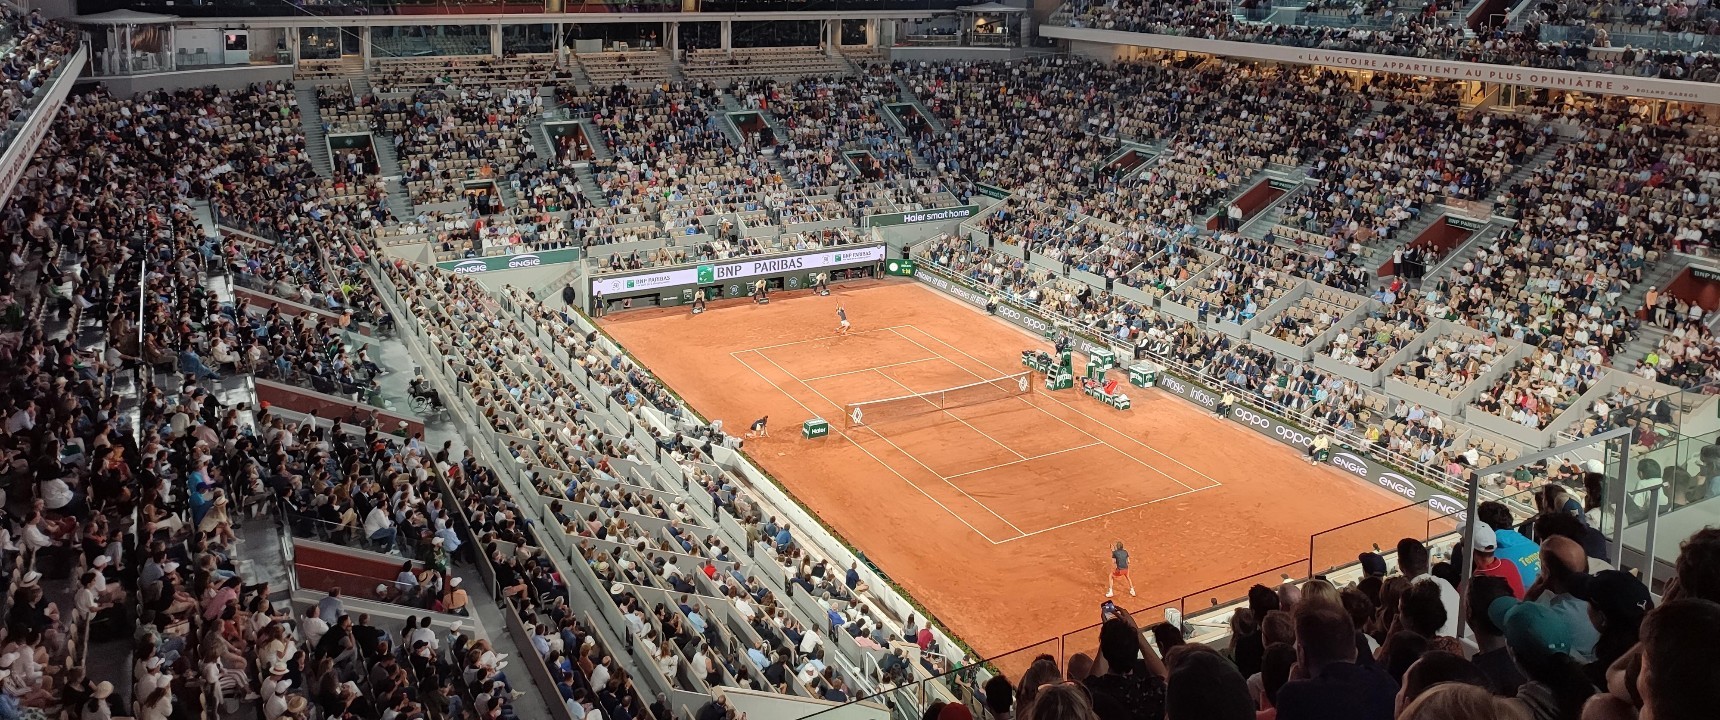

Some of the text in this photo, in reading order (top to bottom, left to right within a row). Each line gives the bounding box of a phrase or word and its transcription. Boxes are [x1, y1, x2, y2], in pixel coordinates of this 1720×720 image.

[1308, 53, 1320, 62] LA
[1324, 55, 1377, 67] VICTOIRE
[1382, 62, 1459, 75] APPARTIENT
[1465, 69, 1482, 77] AU
[1489, 71, 1522, 81] PLUS
[904, 209, 970, 223] Haier smart home
[717, 257, 803, 278] BNP PARIBAS
[1694, 270, 1710, 279] BNP
[998, 305, 1046, 330] oppo oppo
[1161, 374, 1216, 407] Infosys Infosys
[1234, 407, 1270, 429] oppo
